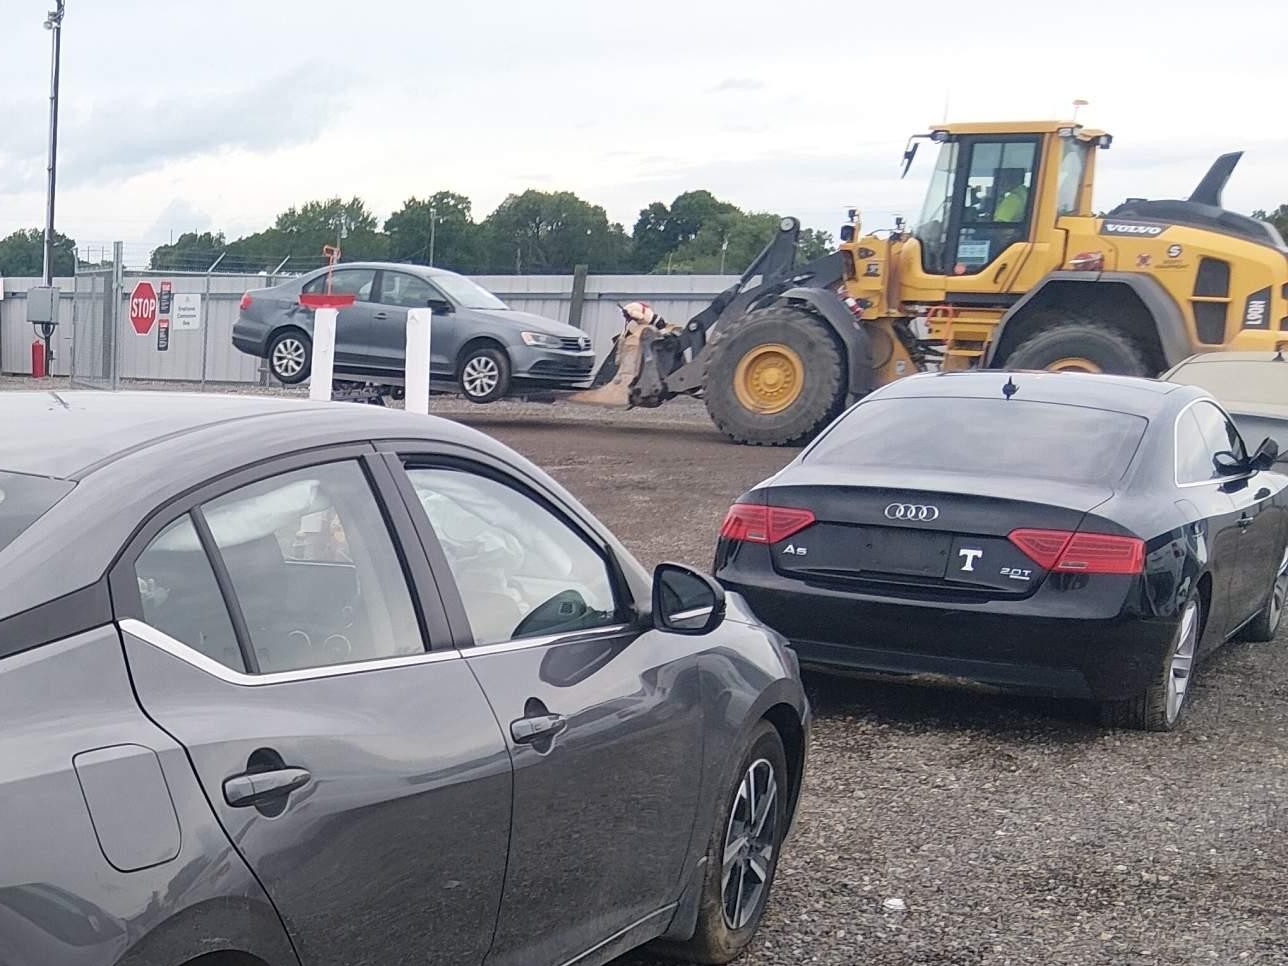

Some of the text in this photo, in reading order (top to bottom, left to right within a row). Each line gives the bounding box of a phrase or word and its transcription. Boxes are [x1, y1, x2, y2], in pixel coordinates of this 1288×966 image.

[1106, 223, 1162, 234] VOLVO
[131, 298, 156, 319] STOP
[782, 544, 808, 556] A5
[958, 548, 984, 572] T
